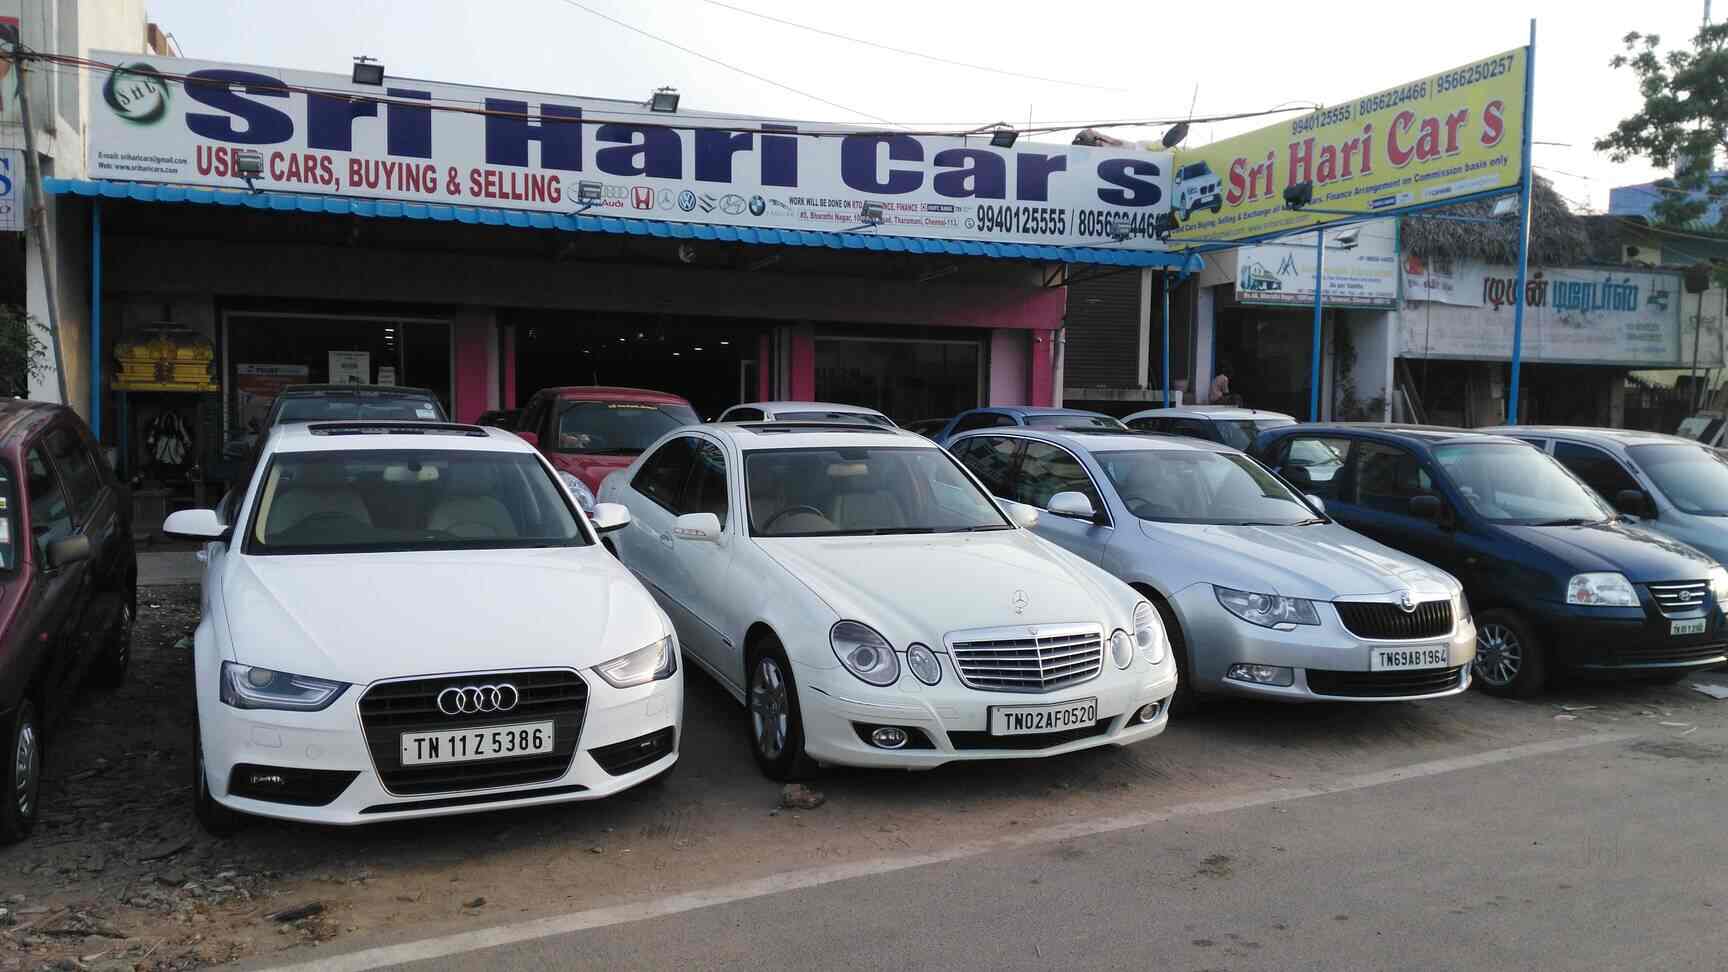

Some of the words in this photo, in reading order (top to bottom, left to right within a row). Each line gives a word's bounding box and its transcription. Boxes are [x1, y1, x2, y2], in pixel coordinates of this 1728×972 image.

[1291, 106, 1351, 135] 9940125555
[1359, 82, 1427, 116] 8056224466
[1437, 55, 1515, 93] 9566250257
[184, 69, 431, 159] Sri
[485, 98, 798, 187] Hari
[196, 145, 259, 177] USE
[270, 151, 340, 192] CARS,
[349, 158, 437, 194] BUYING
[446, 166, 461, 196] &
[469, 168, 561, 204] SELLING
[1226, 150, 1275, 207] Sri
[1288, 124, 1374, 188] Hari
[977, 204, 1066, 235] 9940125555
[1379, 650, 1447, 667] TN69AB1964
[1004, 705, 1094, 730] TN02AF0520
[414, 737, 440, 760] TN
[449, 735, 466, 757] 11
[474, 733, 485, 755] Z
[492, 729, 543, 753] 5386
